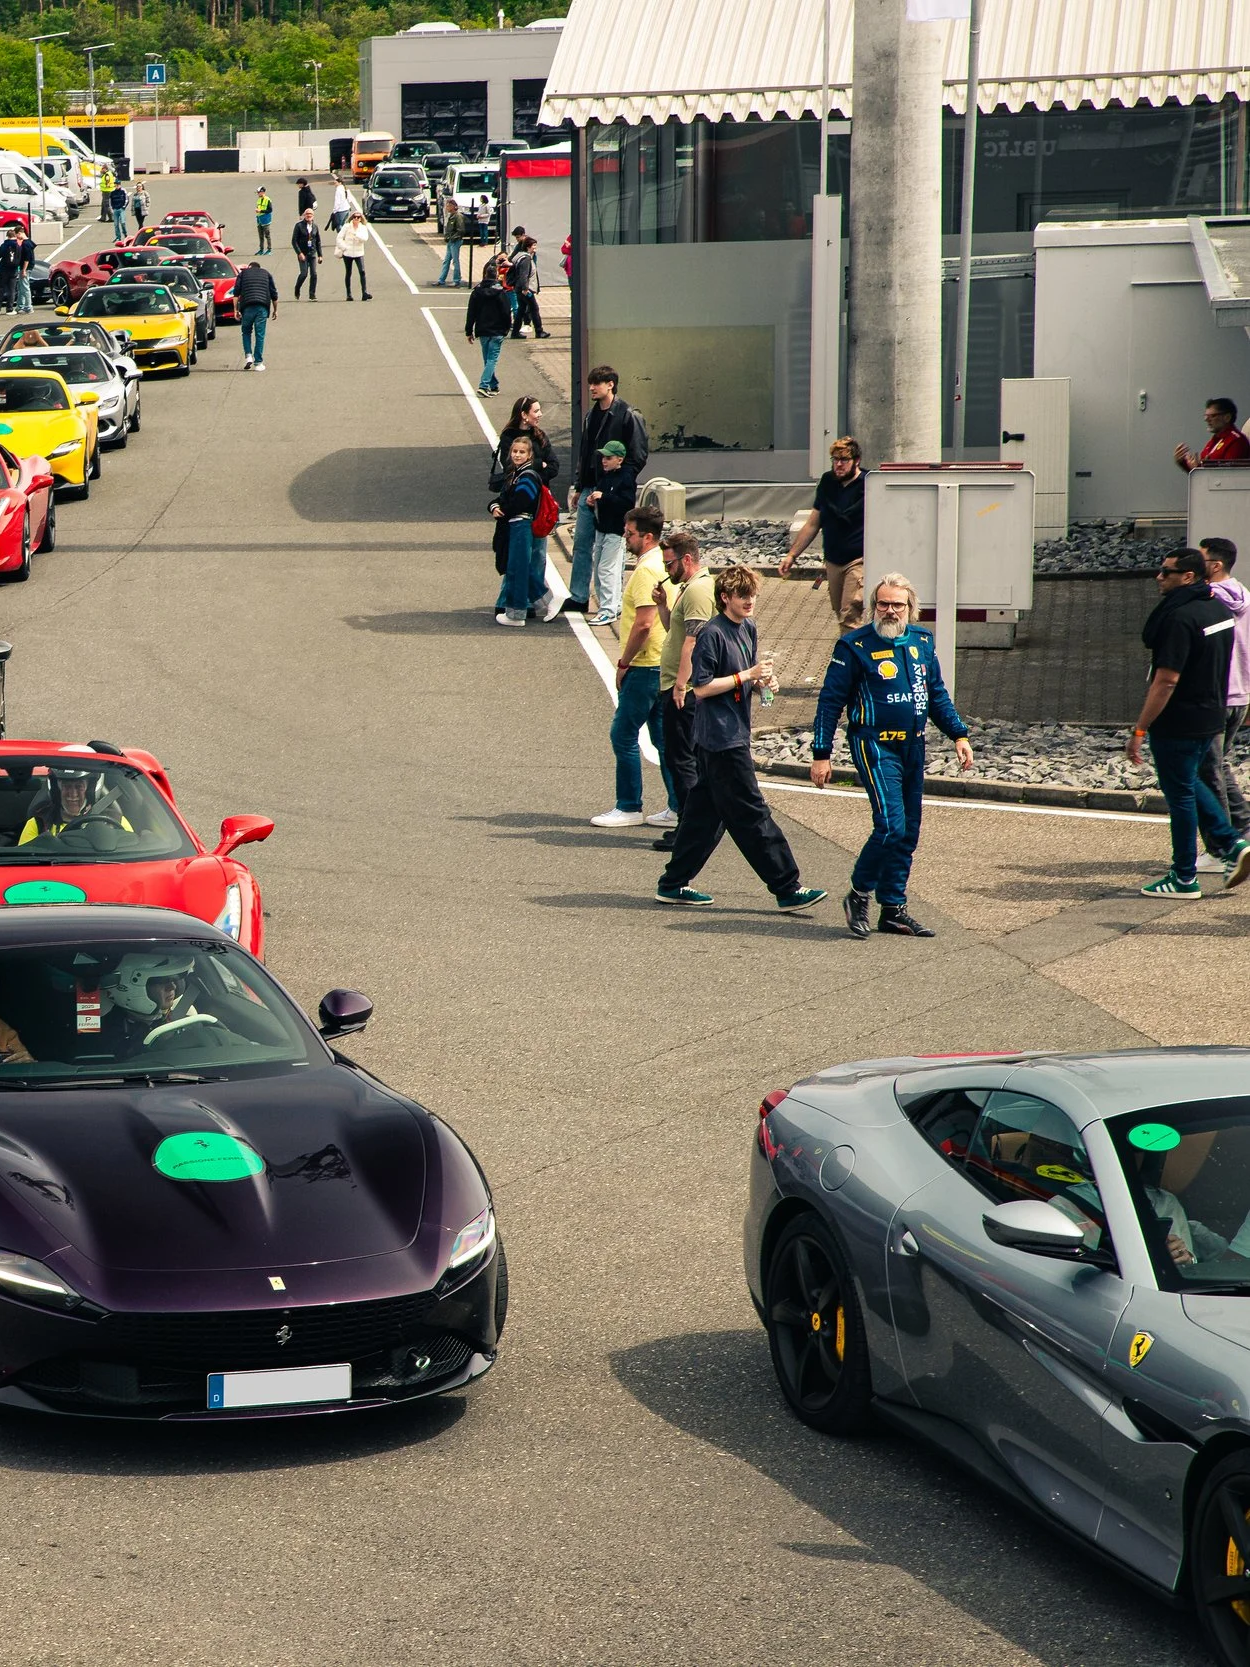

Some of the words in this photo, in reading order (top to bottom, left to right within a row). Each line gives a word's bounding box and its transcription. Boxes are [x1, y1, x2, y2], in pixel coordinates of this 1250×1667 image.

[151, 69, 160, 80] A
[879, 731, 907, 741] 175
[213, 1394, 220, 1403] D
